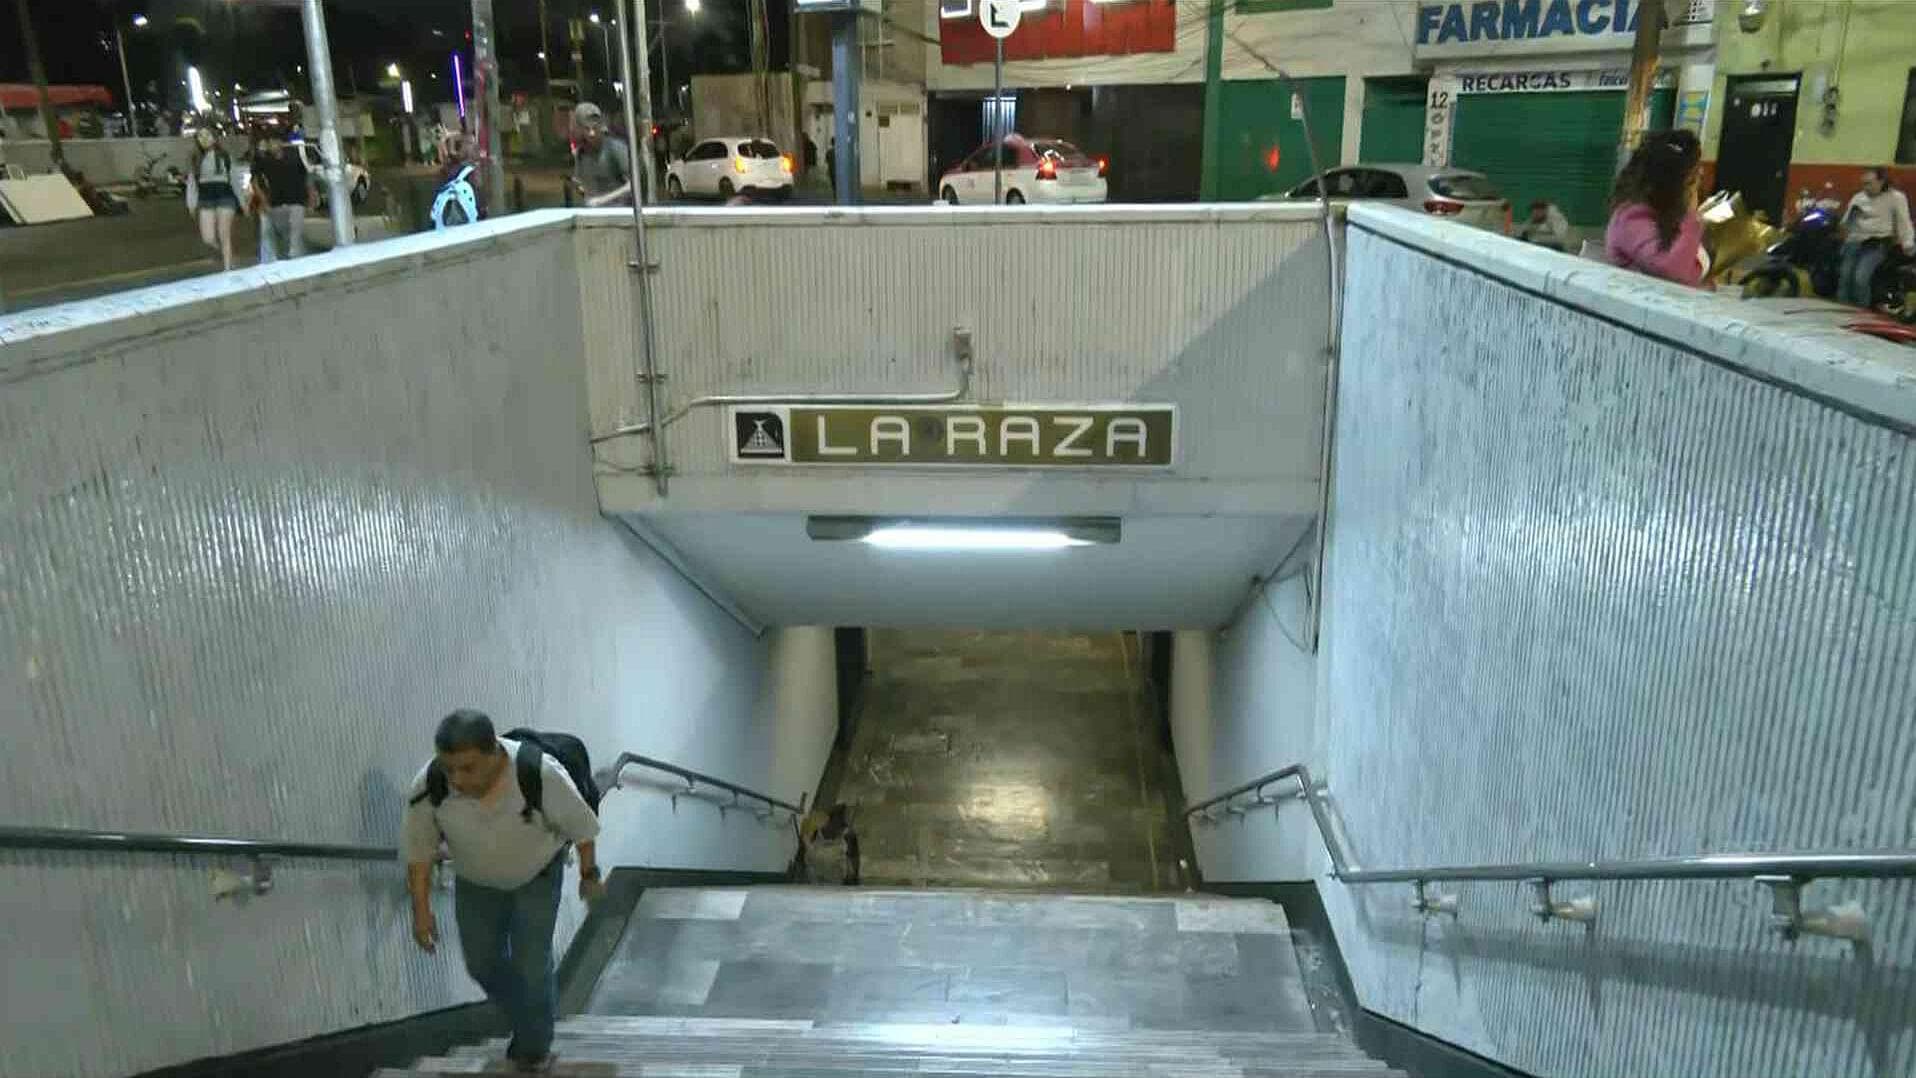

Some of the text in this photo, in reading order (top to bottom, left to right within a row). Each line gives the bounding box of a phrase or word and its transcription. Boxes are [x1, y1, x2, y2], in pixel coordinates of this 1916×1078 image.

[1462, 72, 1571, 91] RECARGAS
[1431, 91, 1448, 109] 12
[817, 415, 1148, 457] LA RAZA
